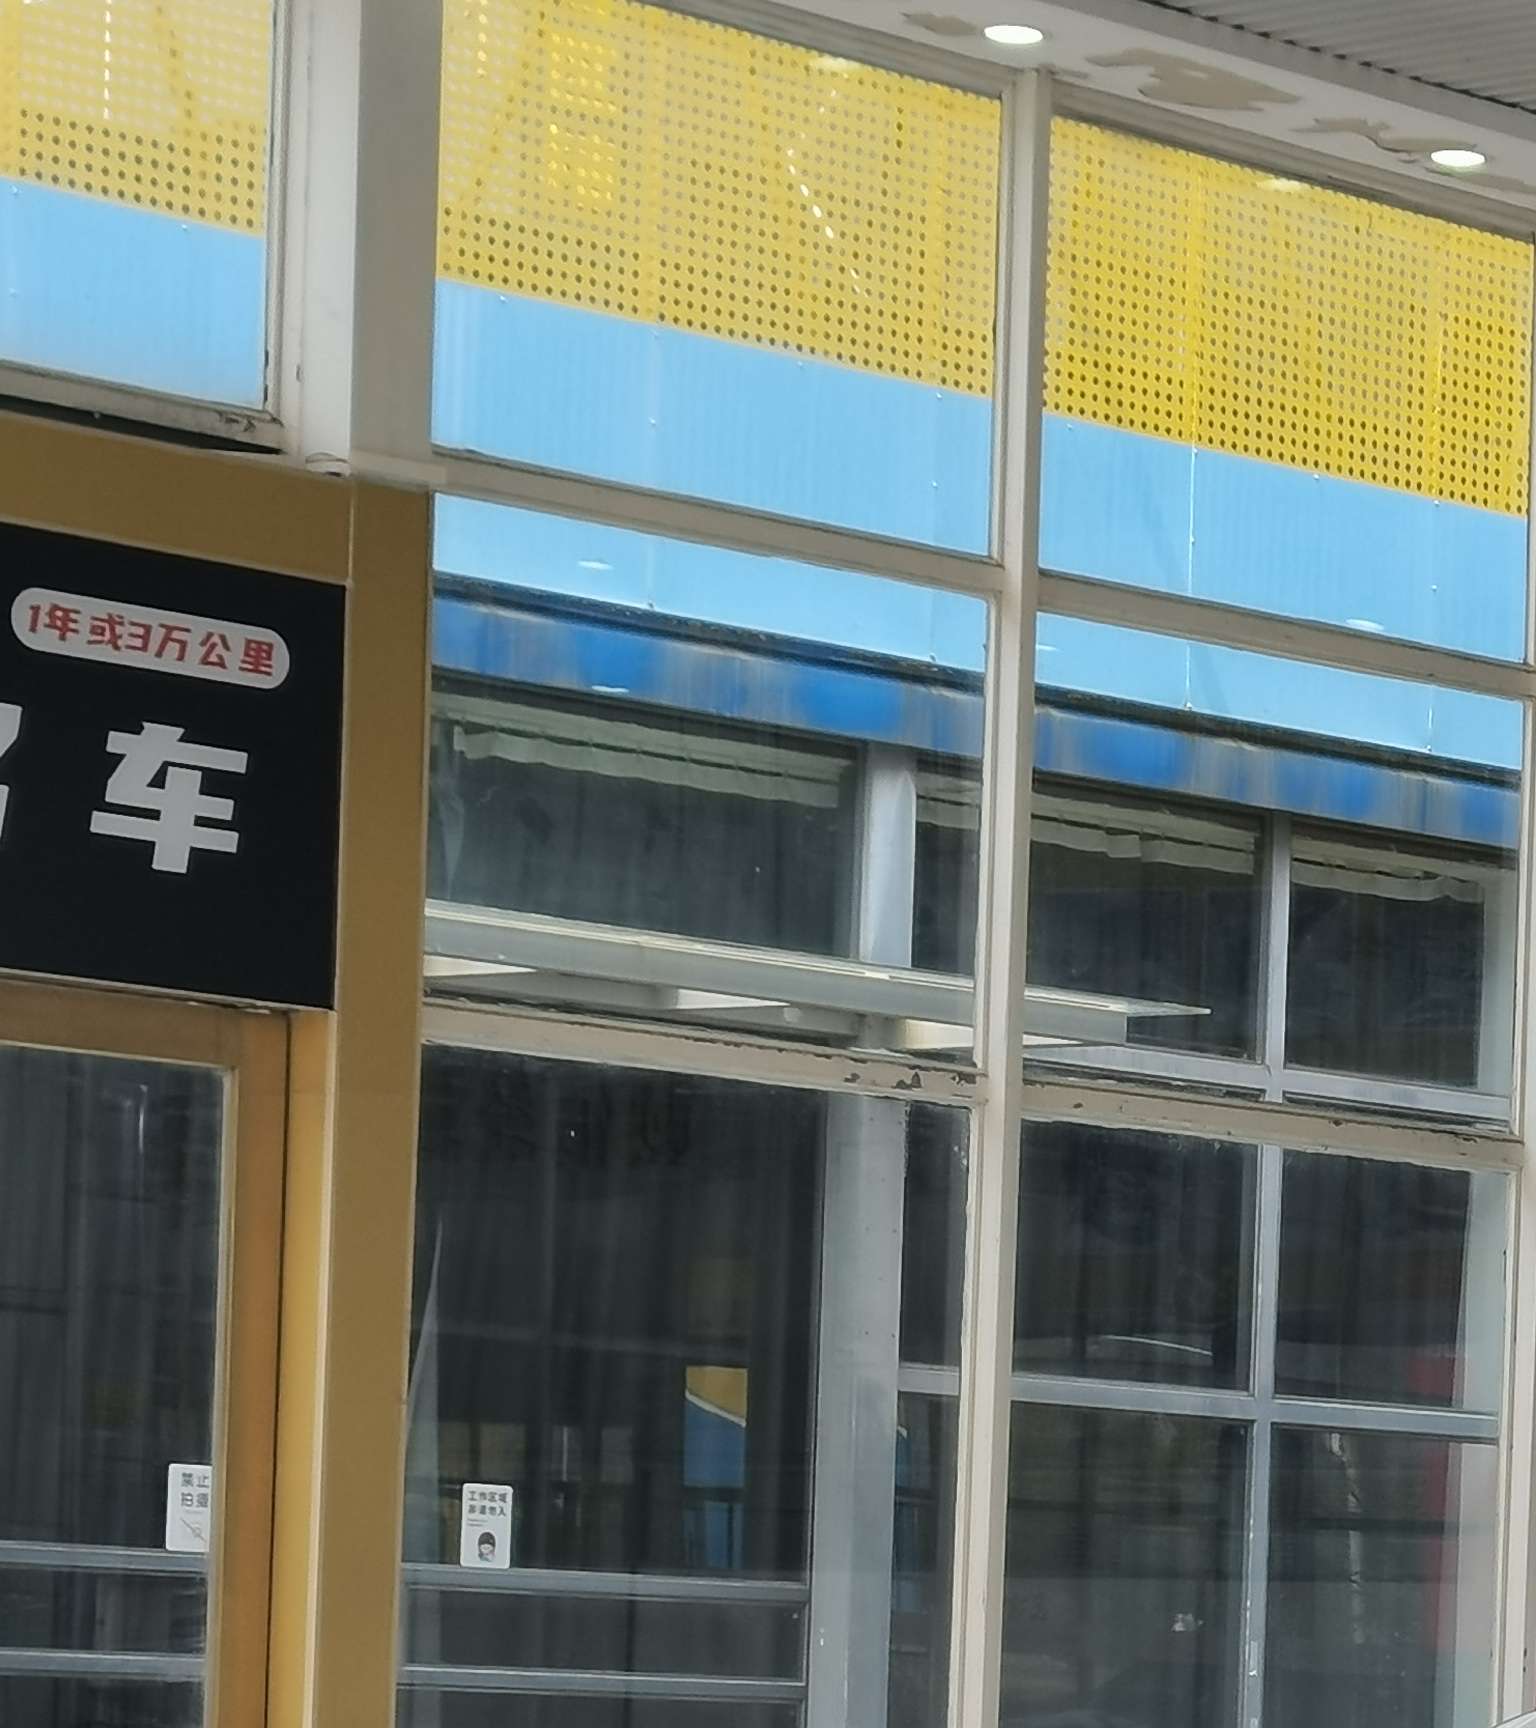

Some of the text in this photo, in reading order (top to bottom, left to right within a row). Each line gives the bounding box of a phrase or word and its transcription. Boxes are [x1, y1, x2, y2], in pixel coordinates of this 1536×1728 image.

[27, 601, 276, 677] 1年或3万公里
